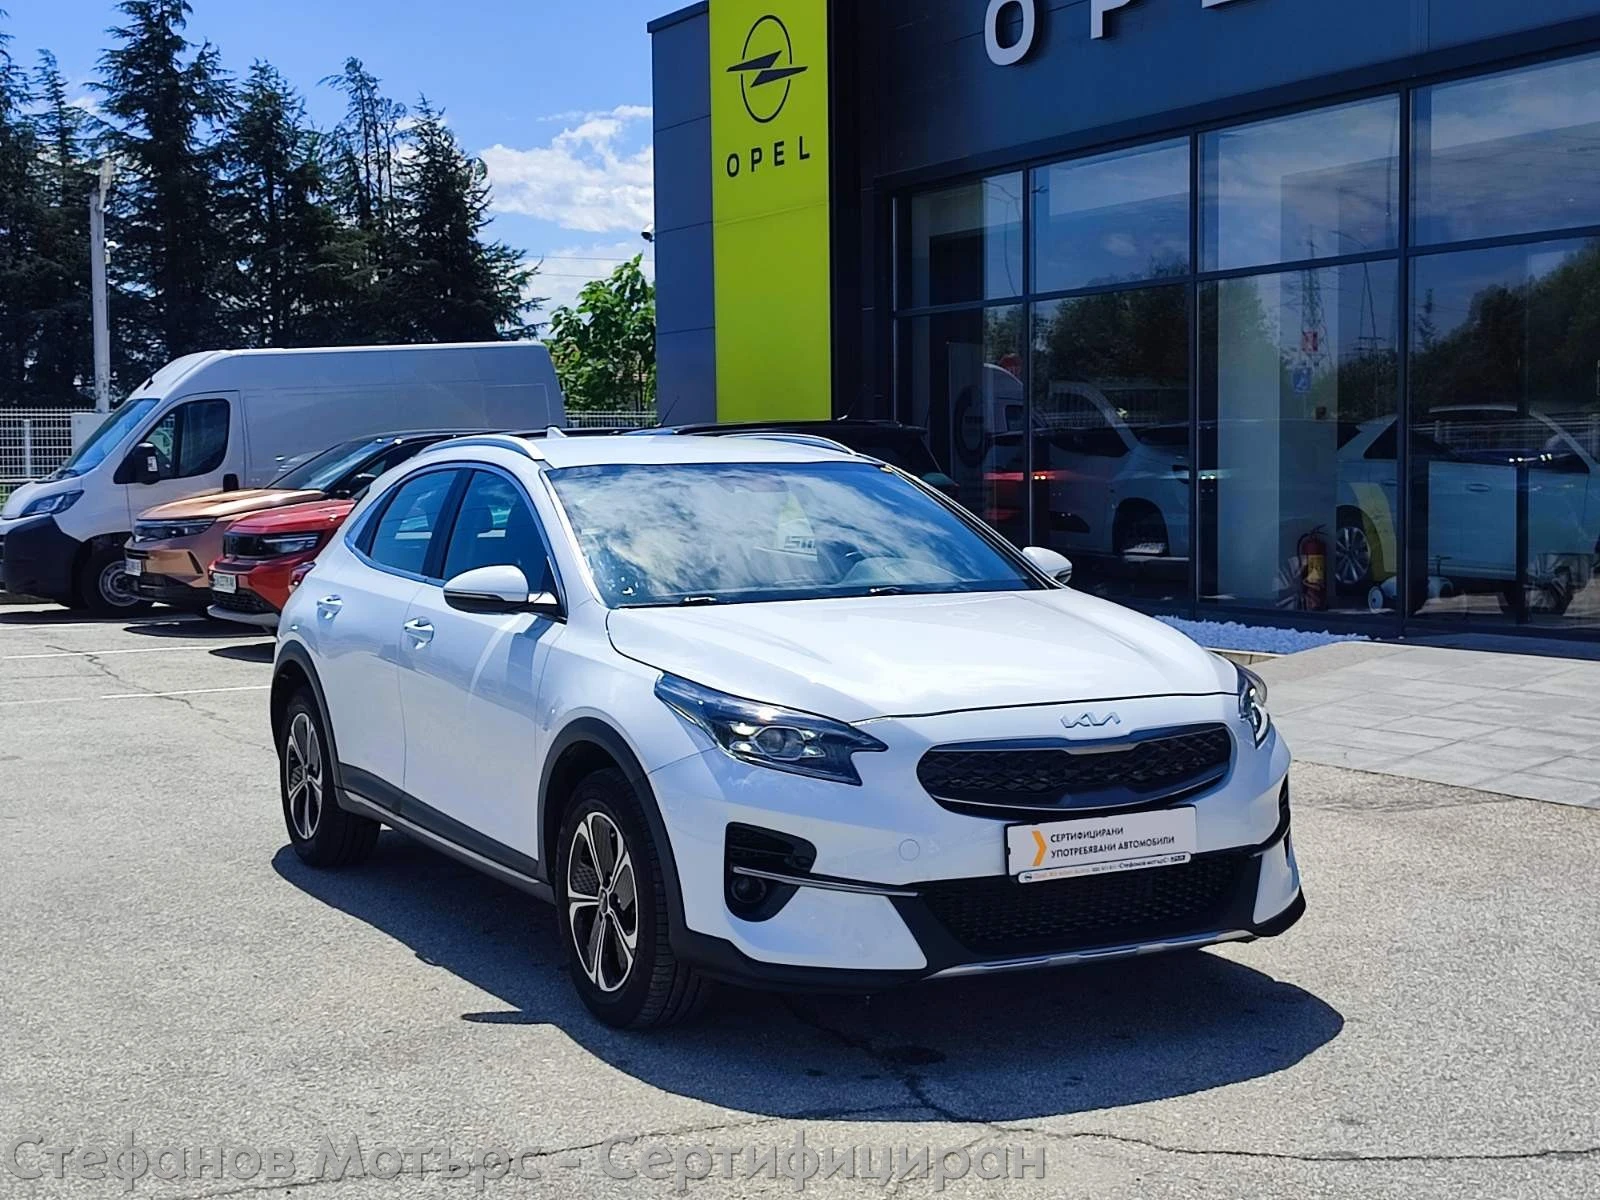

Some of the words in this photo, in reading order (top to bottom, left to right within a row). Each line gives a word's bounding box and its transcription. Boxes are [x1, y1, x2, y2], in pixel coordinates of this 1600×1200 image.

[726, 136, 810, 178] OPEL
[1050, 827, 1124, 843] СЕРТИФИЦИРАНИ
[1051, 843, 1117, 859] УПОТРЕБЯВАНИ
[1117, 835, 1175, 850] АВТОМОБИЛИ
